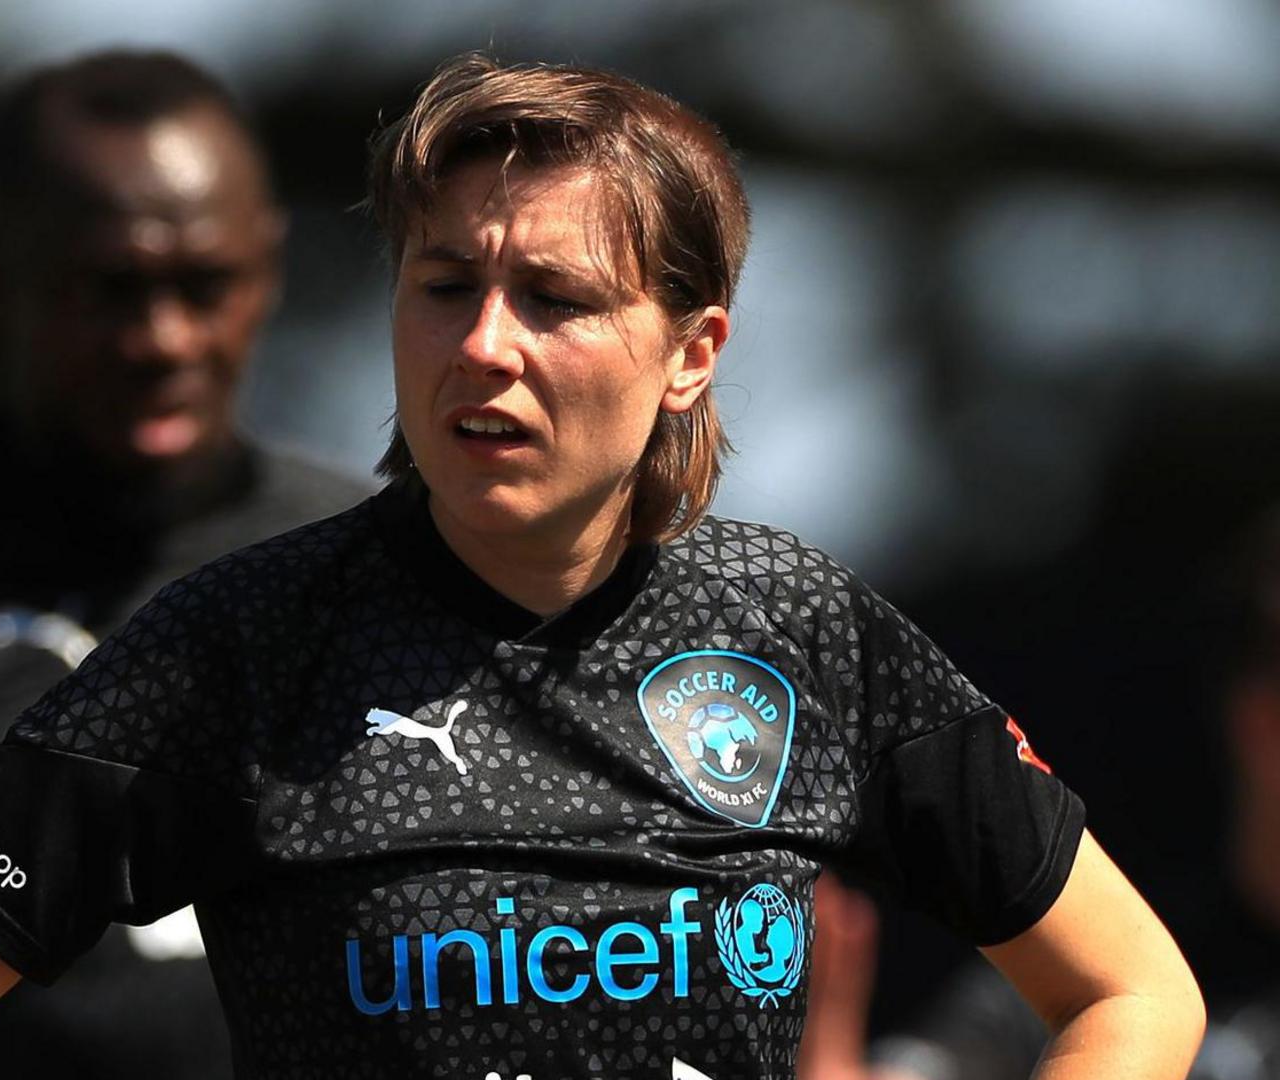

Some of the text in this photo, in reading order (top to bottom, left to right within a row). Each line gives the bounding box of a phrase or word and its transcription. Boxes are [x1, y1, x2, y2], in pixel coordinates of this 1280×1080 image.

[658, 671, 779, 722] SOCCER AID
[697, 778, 768, 806] WORLD XI FC
[345, 887, 701, 1016] unicef
